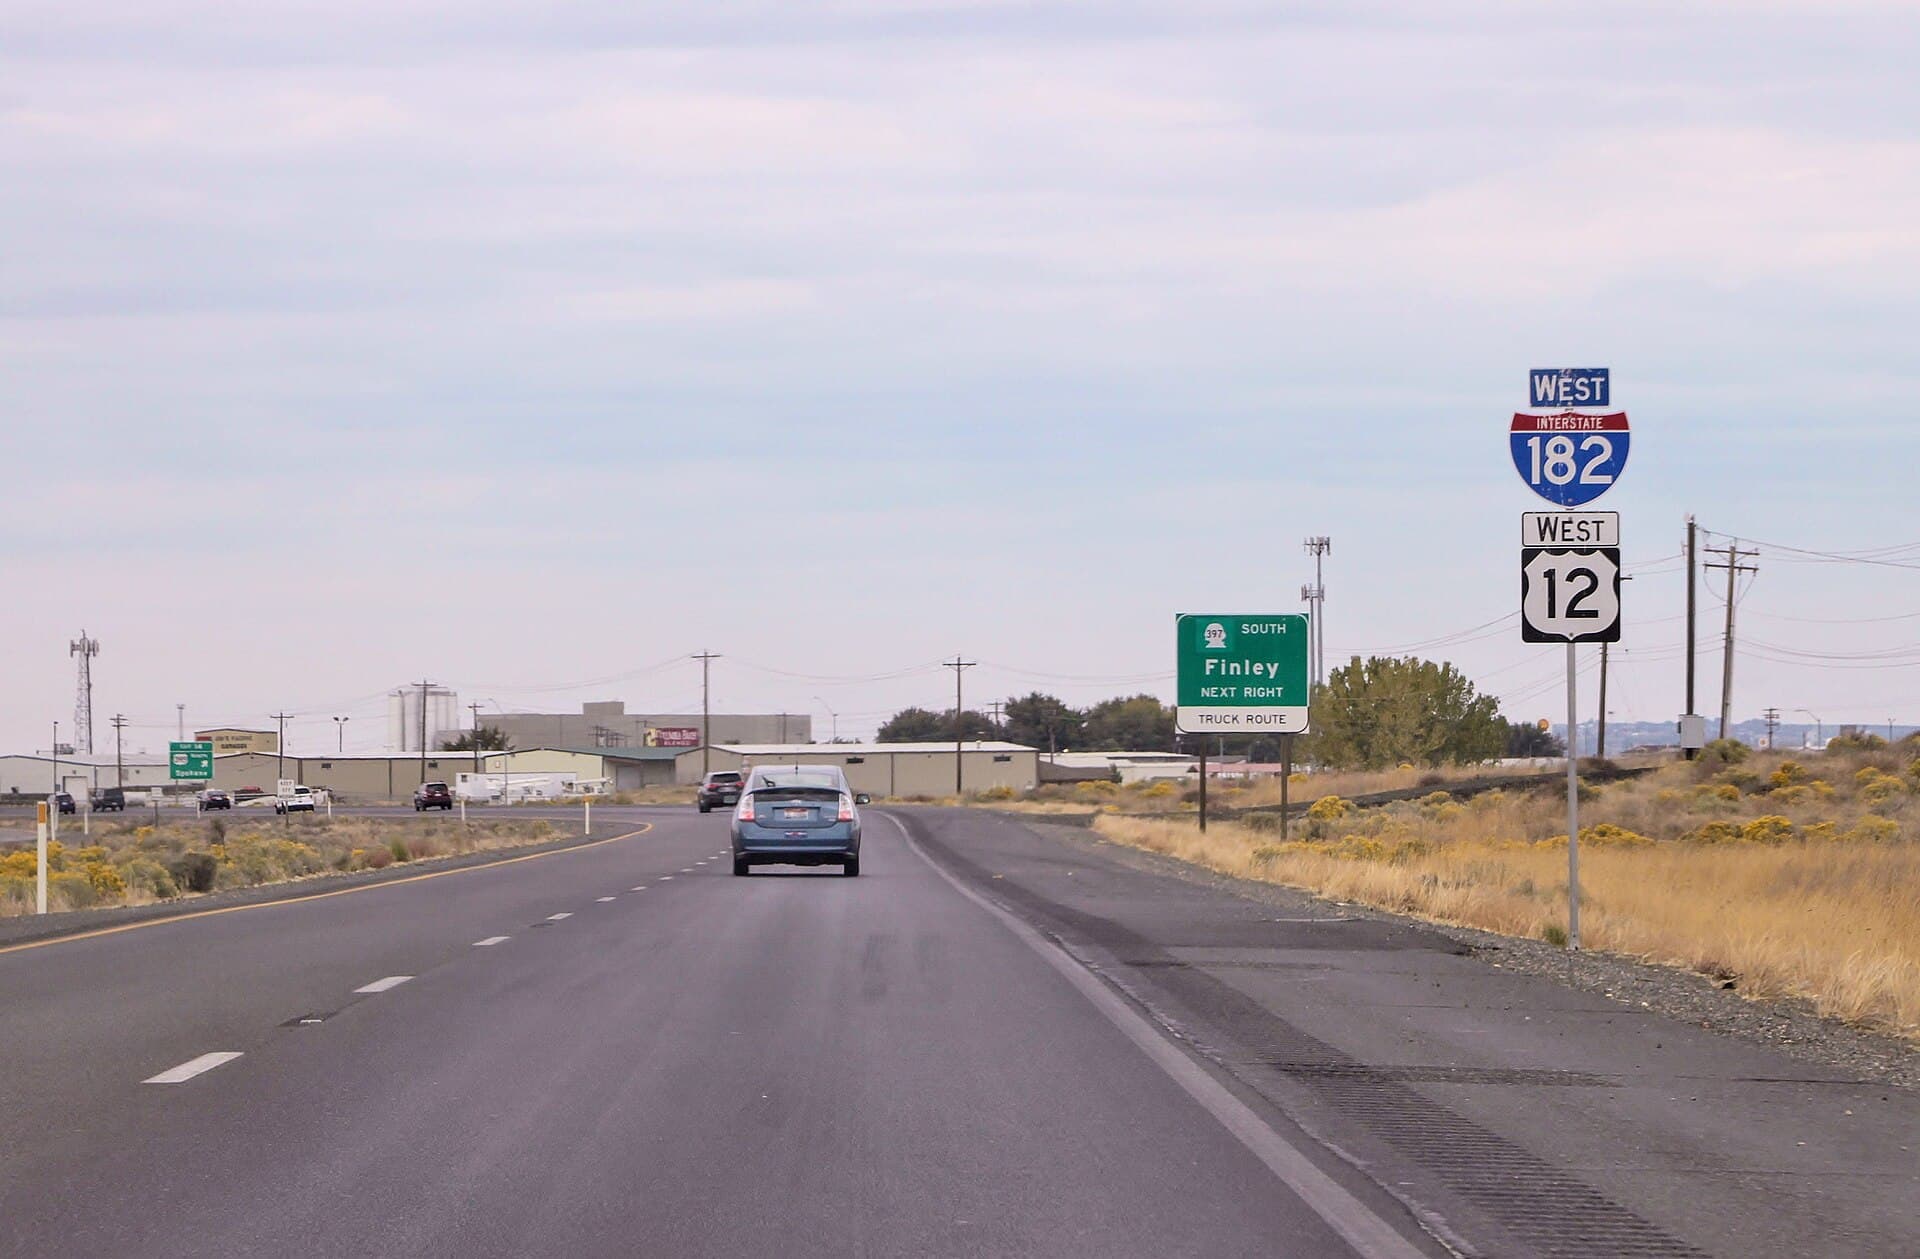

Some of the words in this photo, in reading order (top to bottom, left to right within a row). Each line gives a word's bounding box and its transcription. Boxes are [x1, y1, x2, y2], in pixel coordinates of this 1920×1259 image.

[1534, 375, 1605, 401] WEST
[1536, 417, 1604, 430] INTERSTATE
[1527, 435, 1613, 485] 182
[1537, 516, 1605, 542] WEST
[1543, 567, 1599, 619] 12
[1206, 629, 1223, 639] 397
[1241, 623, 1286, 634] SOUTH
[1205, 659, 1279, 679] Finley
[1201, 687, 1237, 697] NEXT
[1244, 687, 1284, 697] RIGHT
[1198, 714, 1240, 724] TRUCK
[1246, 714, 1287, 724] ROUTE
